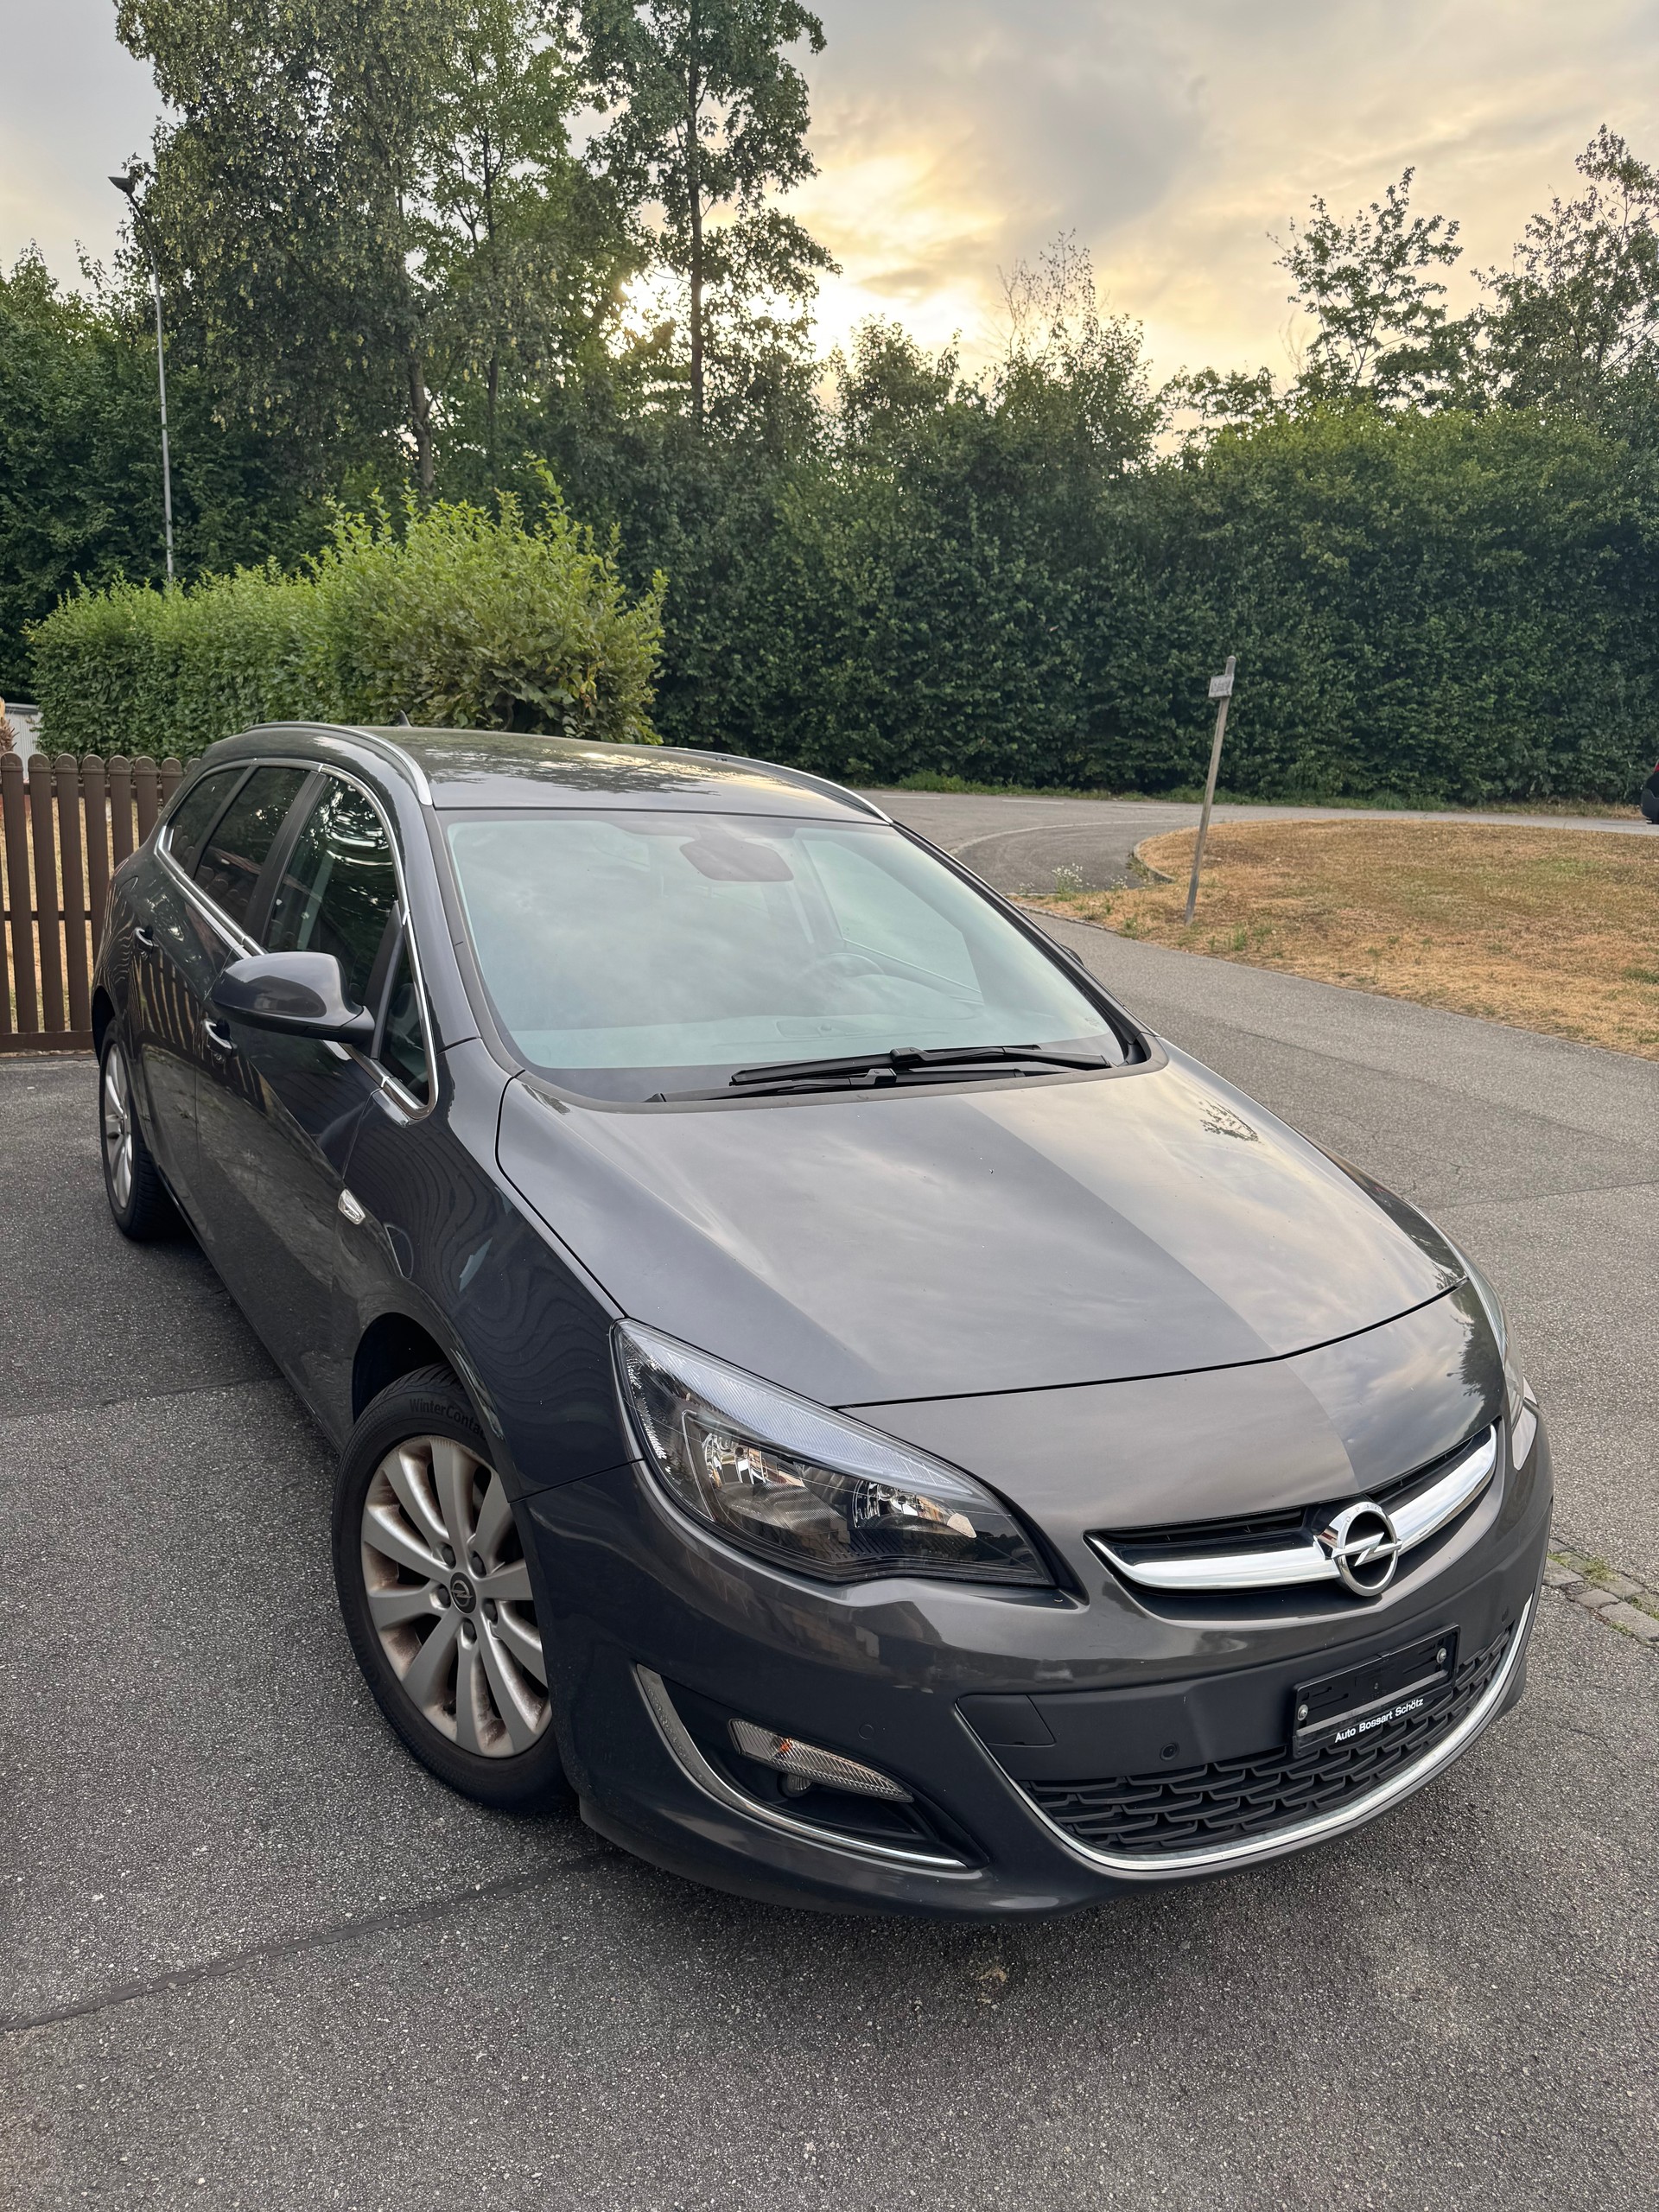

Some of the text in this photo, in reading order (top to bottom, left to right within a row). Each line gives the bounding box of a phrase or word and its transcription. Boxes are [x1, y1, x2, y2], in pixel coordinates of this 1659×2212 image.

[409, 1398, 486, 1440] WinterContac
[1334, 1698, 1424, 1744] Auto Bossart Schötz
